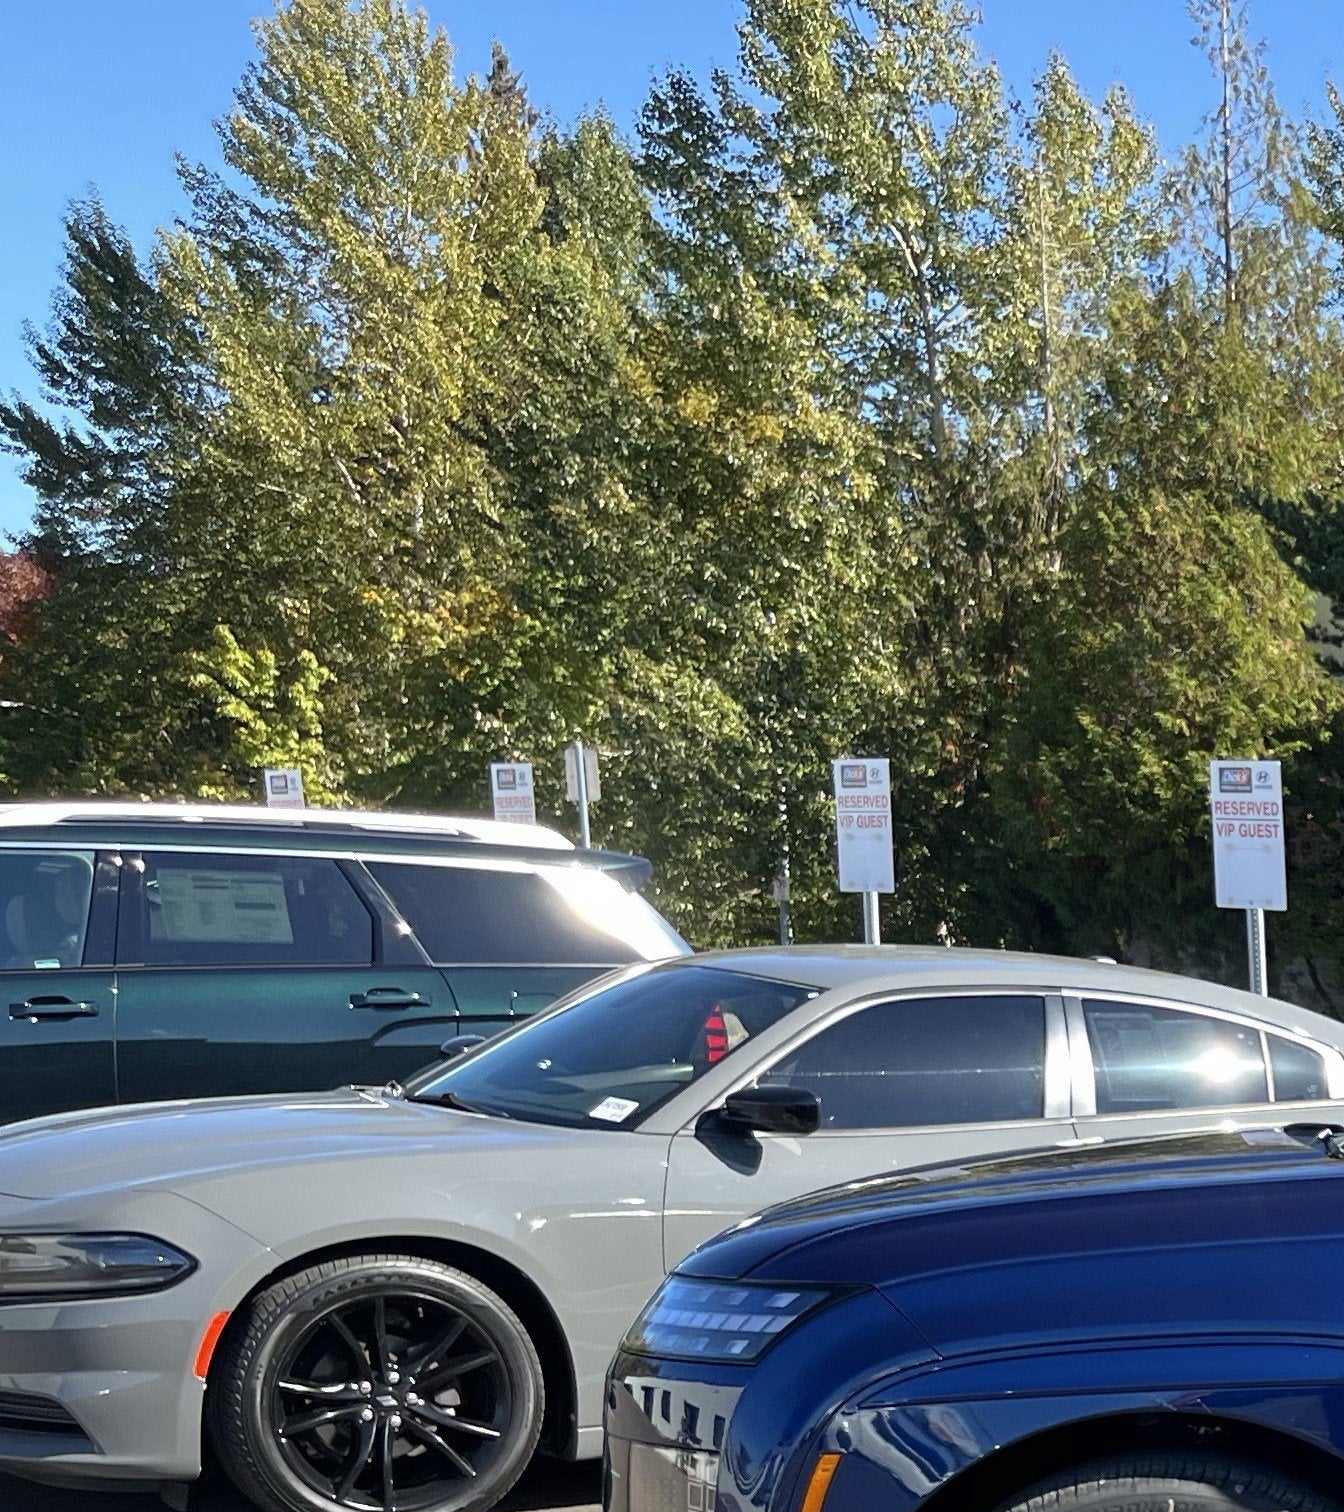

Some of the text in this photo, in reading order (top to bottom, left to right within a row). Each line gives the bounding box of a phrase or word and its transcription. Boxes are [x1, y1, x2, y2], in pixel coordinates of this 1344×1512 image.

[838, 795, 888, 809] RESERVED
[1215, 801, 1279, 816] RESERVED
[839, 815, 888, 829] VIP GUEST
[1216, 823, 1279, 838] VIP GUEST
